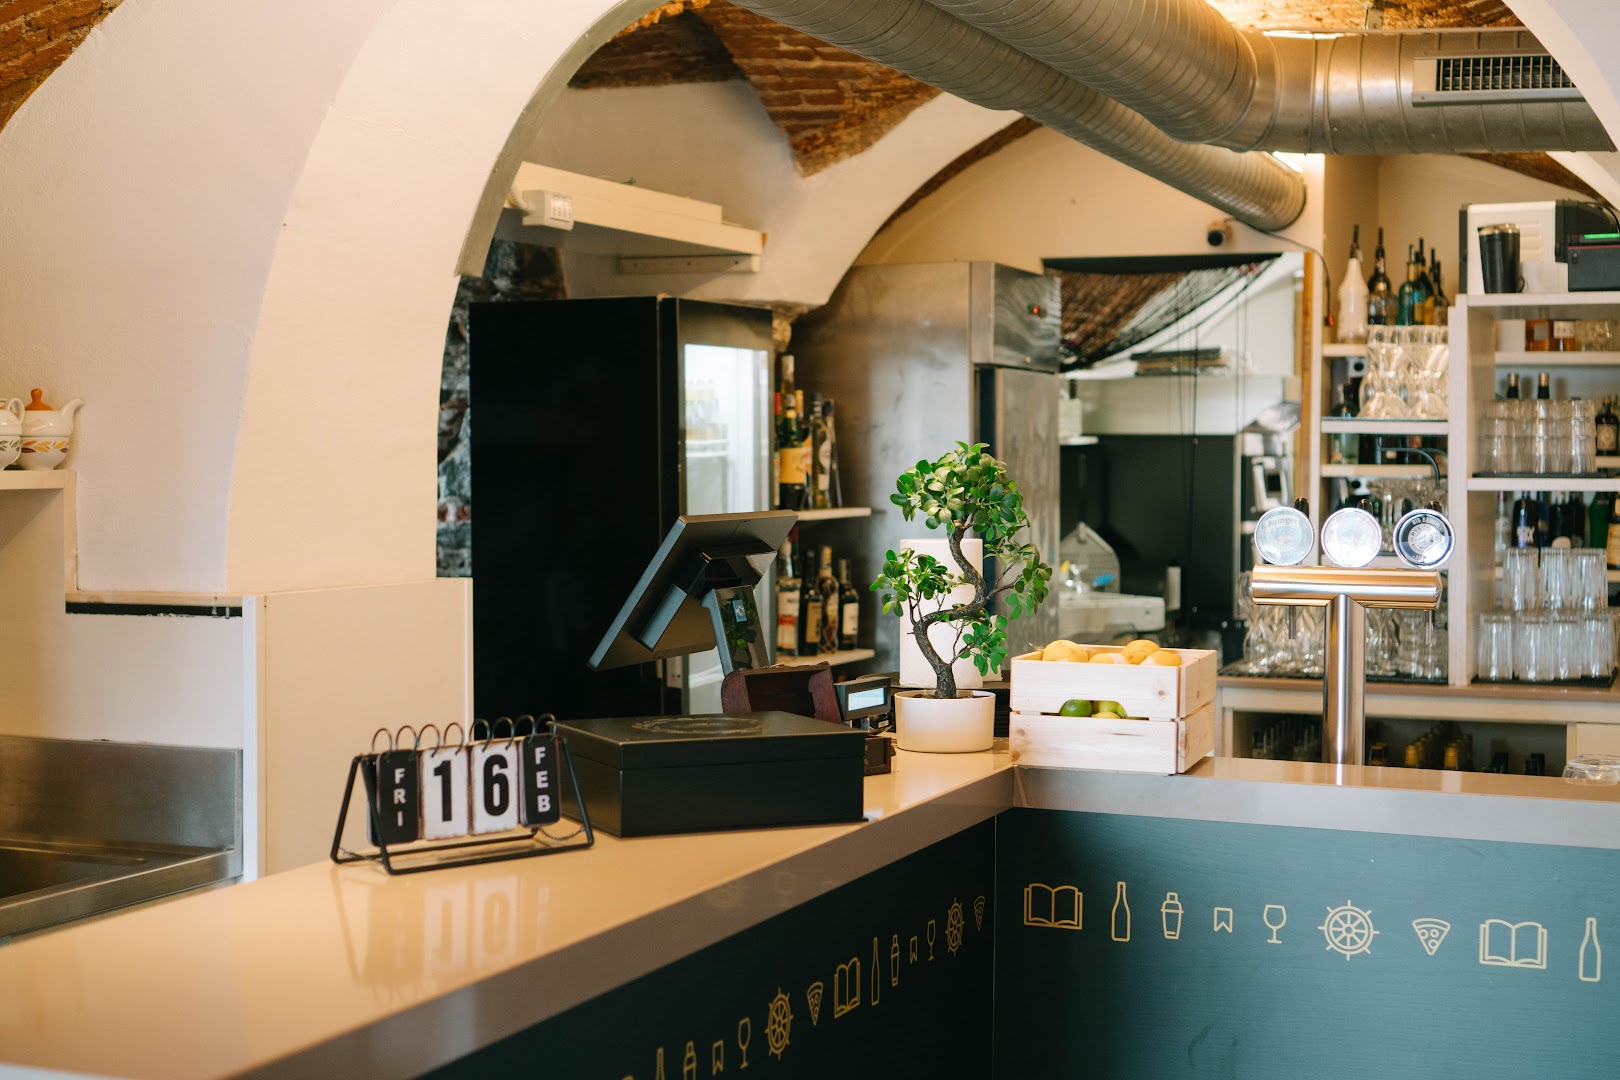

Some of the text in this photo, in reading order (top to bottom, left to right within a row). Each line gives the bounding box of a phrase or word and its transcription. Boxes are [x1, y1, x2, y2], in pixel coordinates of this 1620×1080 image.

[1267, 517, 1298, 528] Ayinger
[393, 767, 406, 827] FRI
[534, 746, 552, 813] FEB
